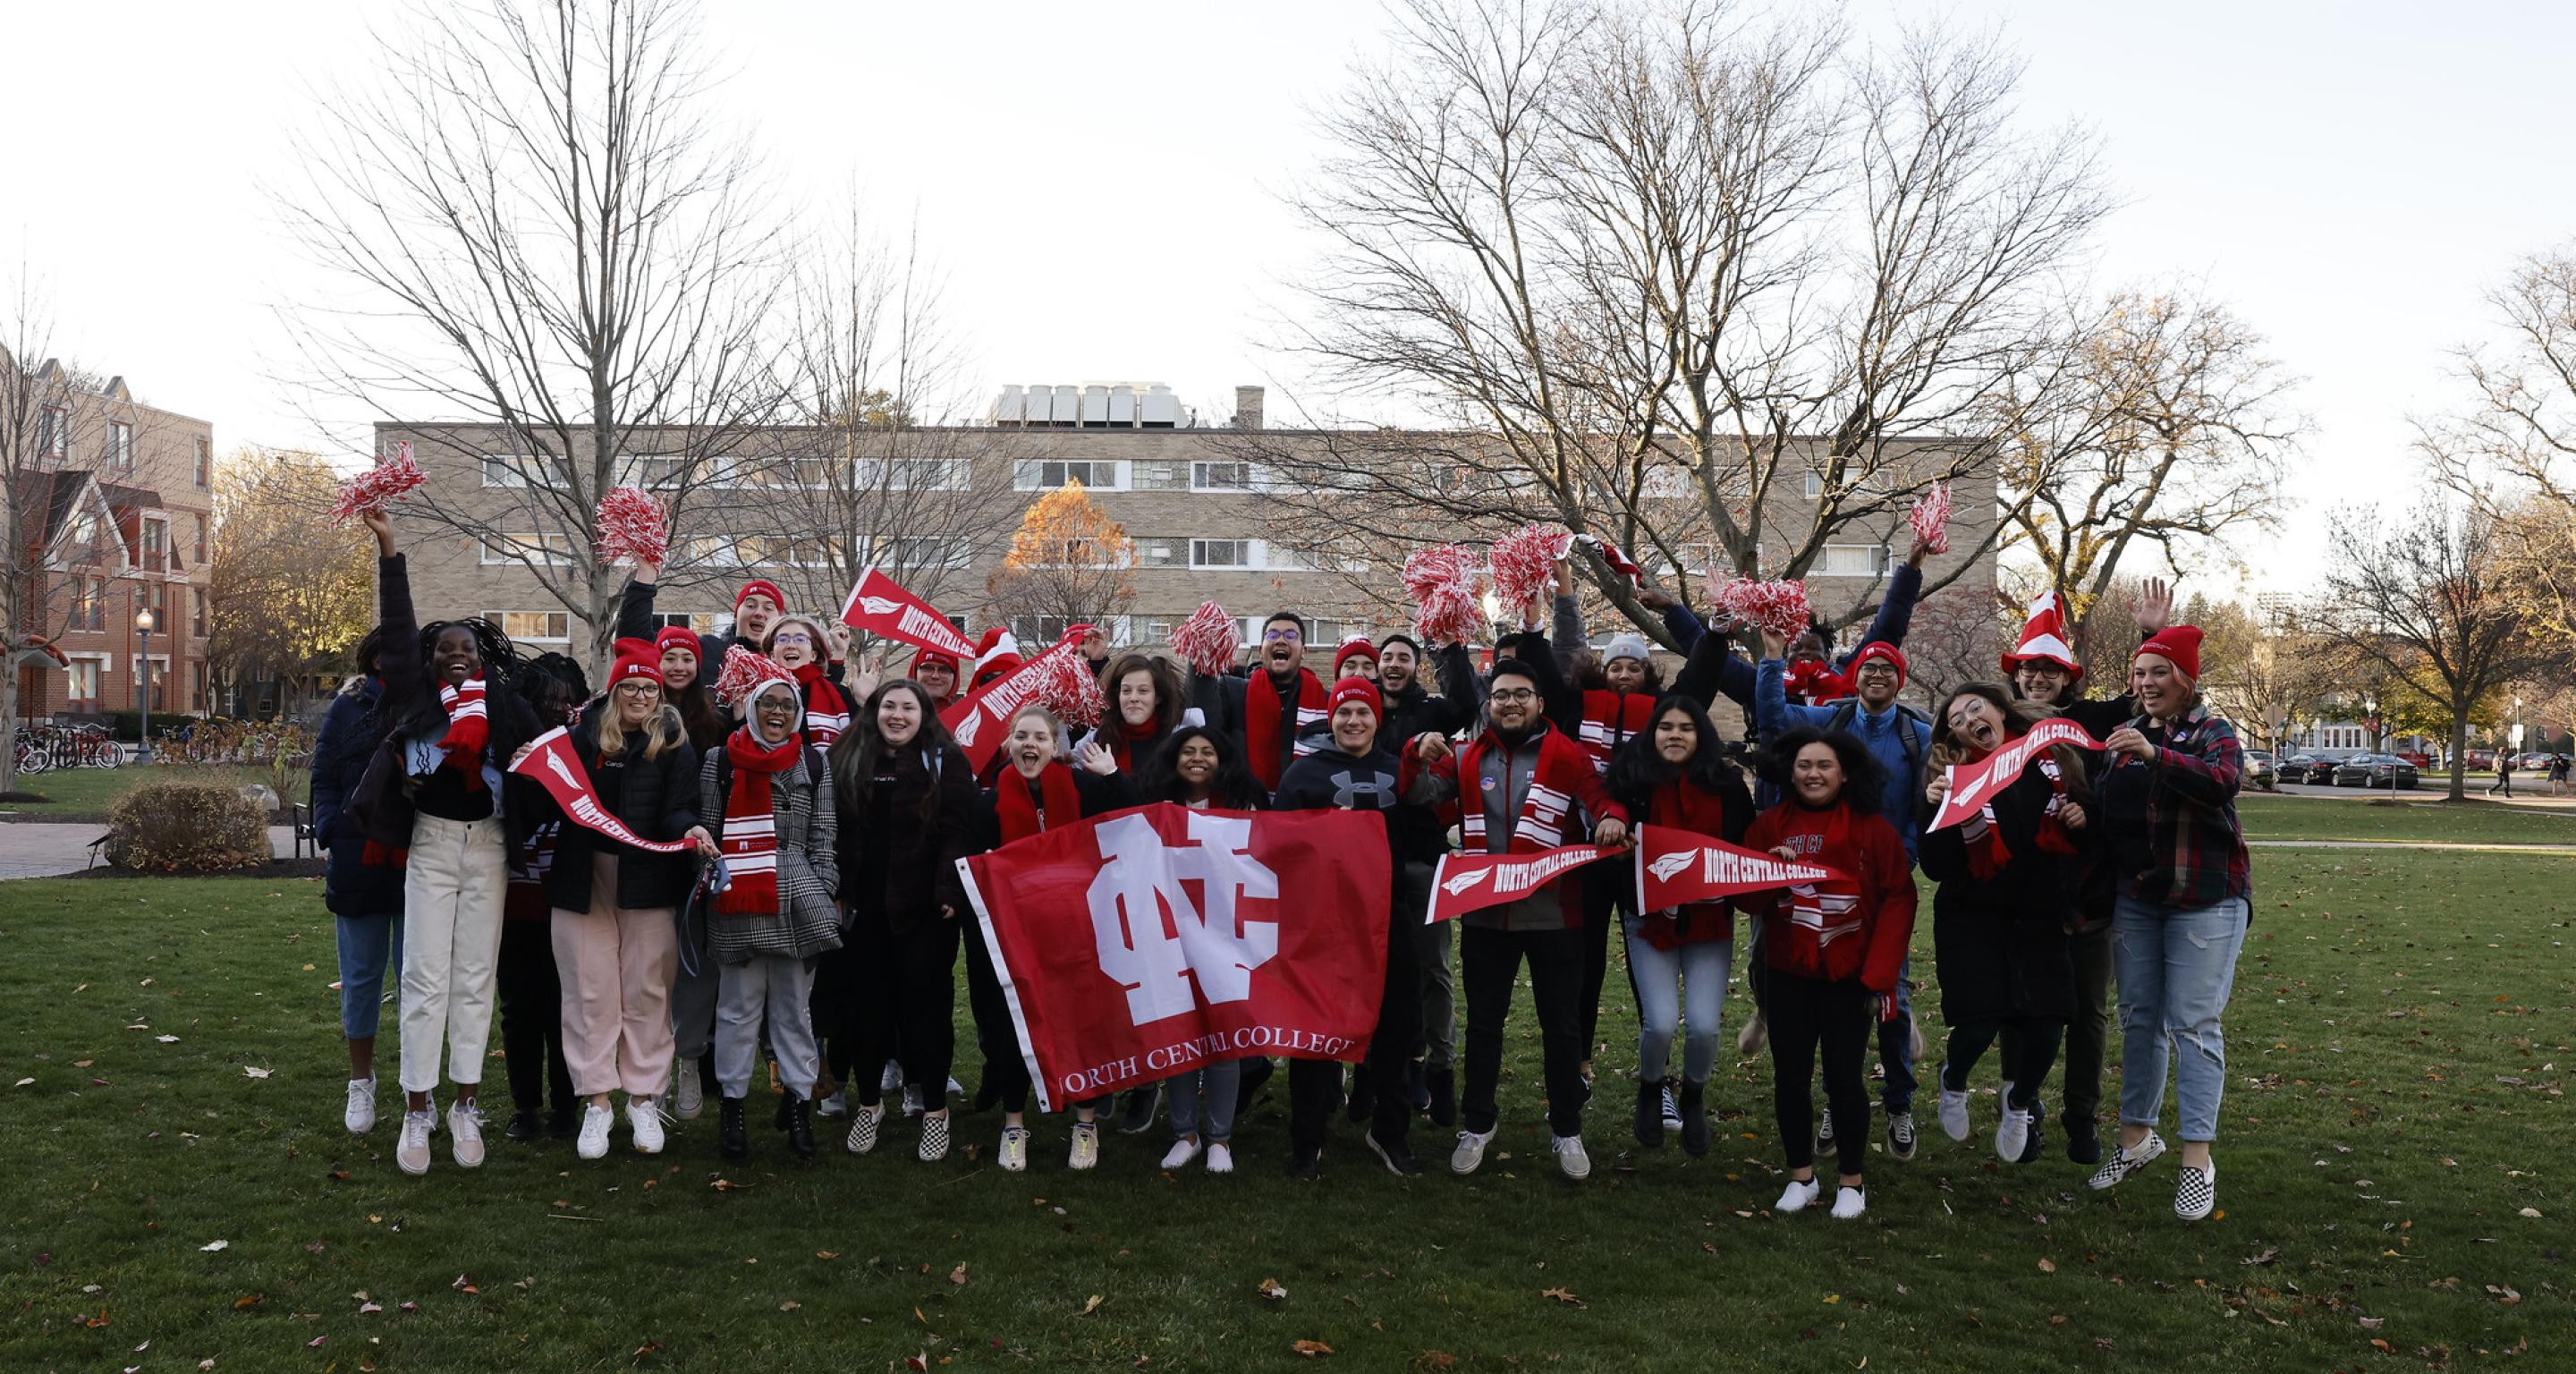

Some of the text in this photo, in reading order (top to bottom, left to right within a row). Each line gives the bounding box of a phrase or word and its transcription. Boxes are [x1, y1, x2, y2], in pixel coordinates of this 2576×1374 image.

[897, 604, 934, 640] NORTH
[926, 620, 962, 653] CENTRAL
[980, 682, 1021, 722] NORTH
[1991, 745, 2022, 787] NORTH
[2051, 724, 2089, 747] COLLEGE
[570, 794, 685, 852] NORTH CENTRAL COLLEGE
[1493, 849, 1597, 893] NORTH CENTRAL COLLEGE
[1703, 847, 1827, 884] NORTH CENTRAL COLLEGE
[1058, 1056, 1140, 1095] ORTH
